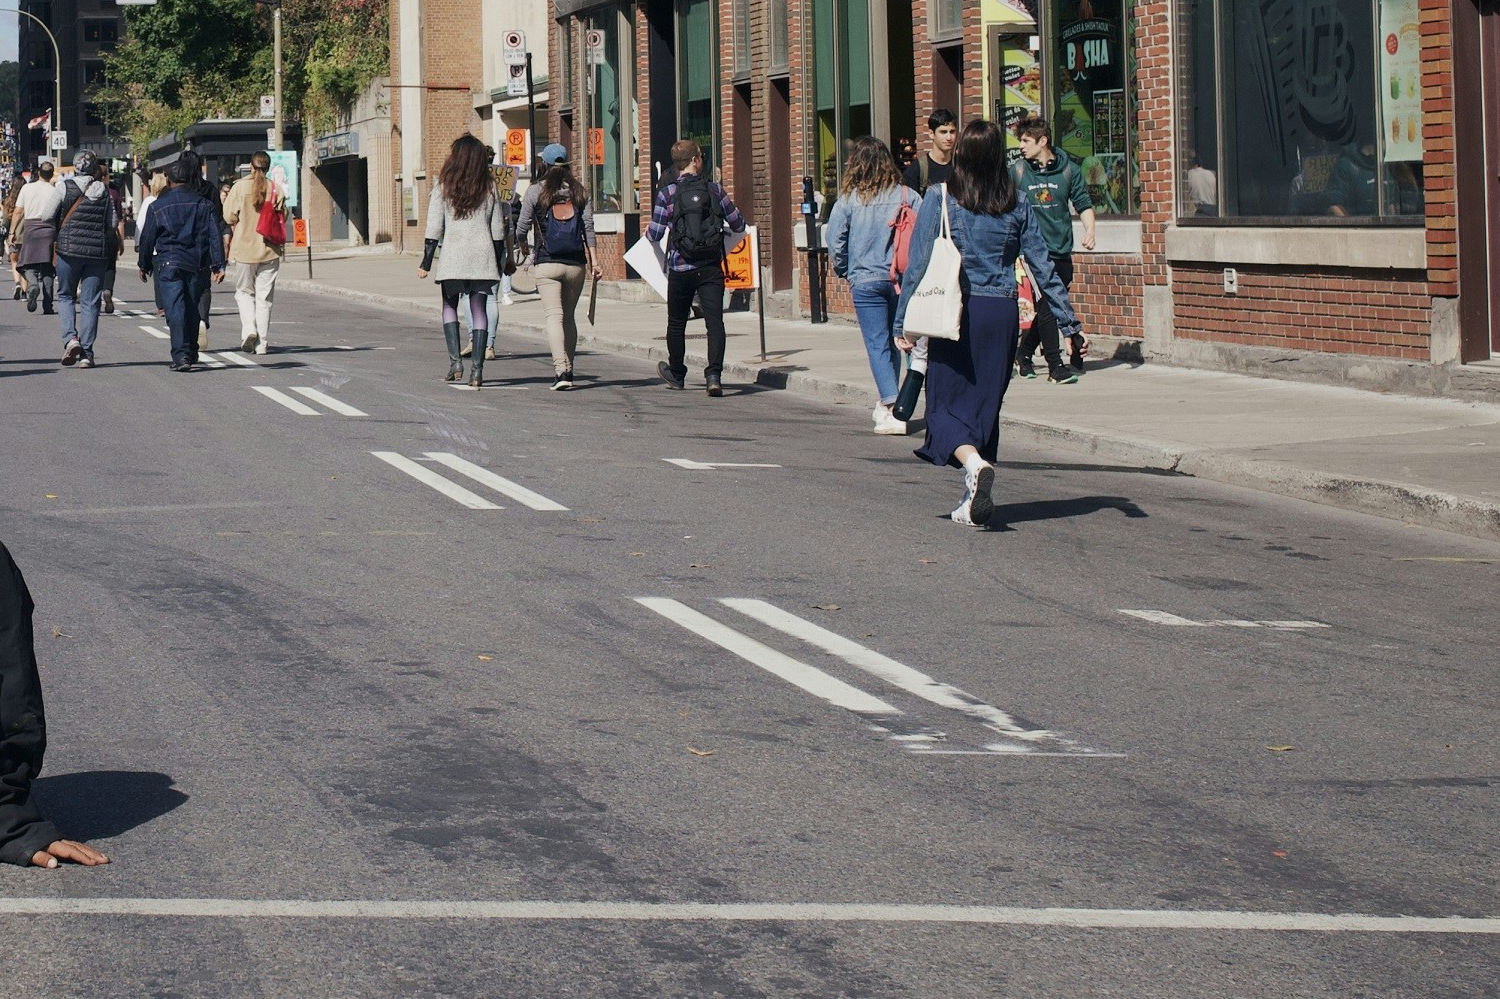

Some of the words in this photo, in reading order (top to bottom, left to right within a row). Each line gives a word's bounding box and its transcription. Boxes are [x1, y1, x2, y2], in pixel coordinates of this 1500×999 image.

[1067, 38, 1110, 70] BASHA
[54, 136, 66, 146] 40
[738, 257, 749, 265] 19h
[933, 286, 946, 296] Oak
